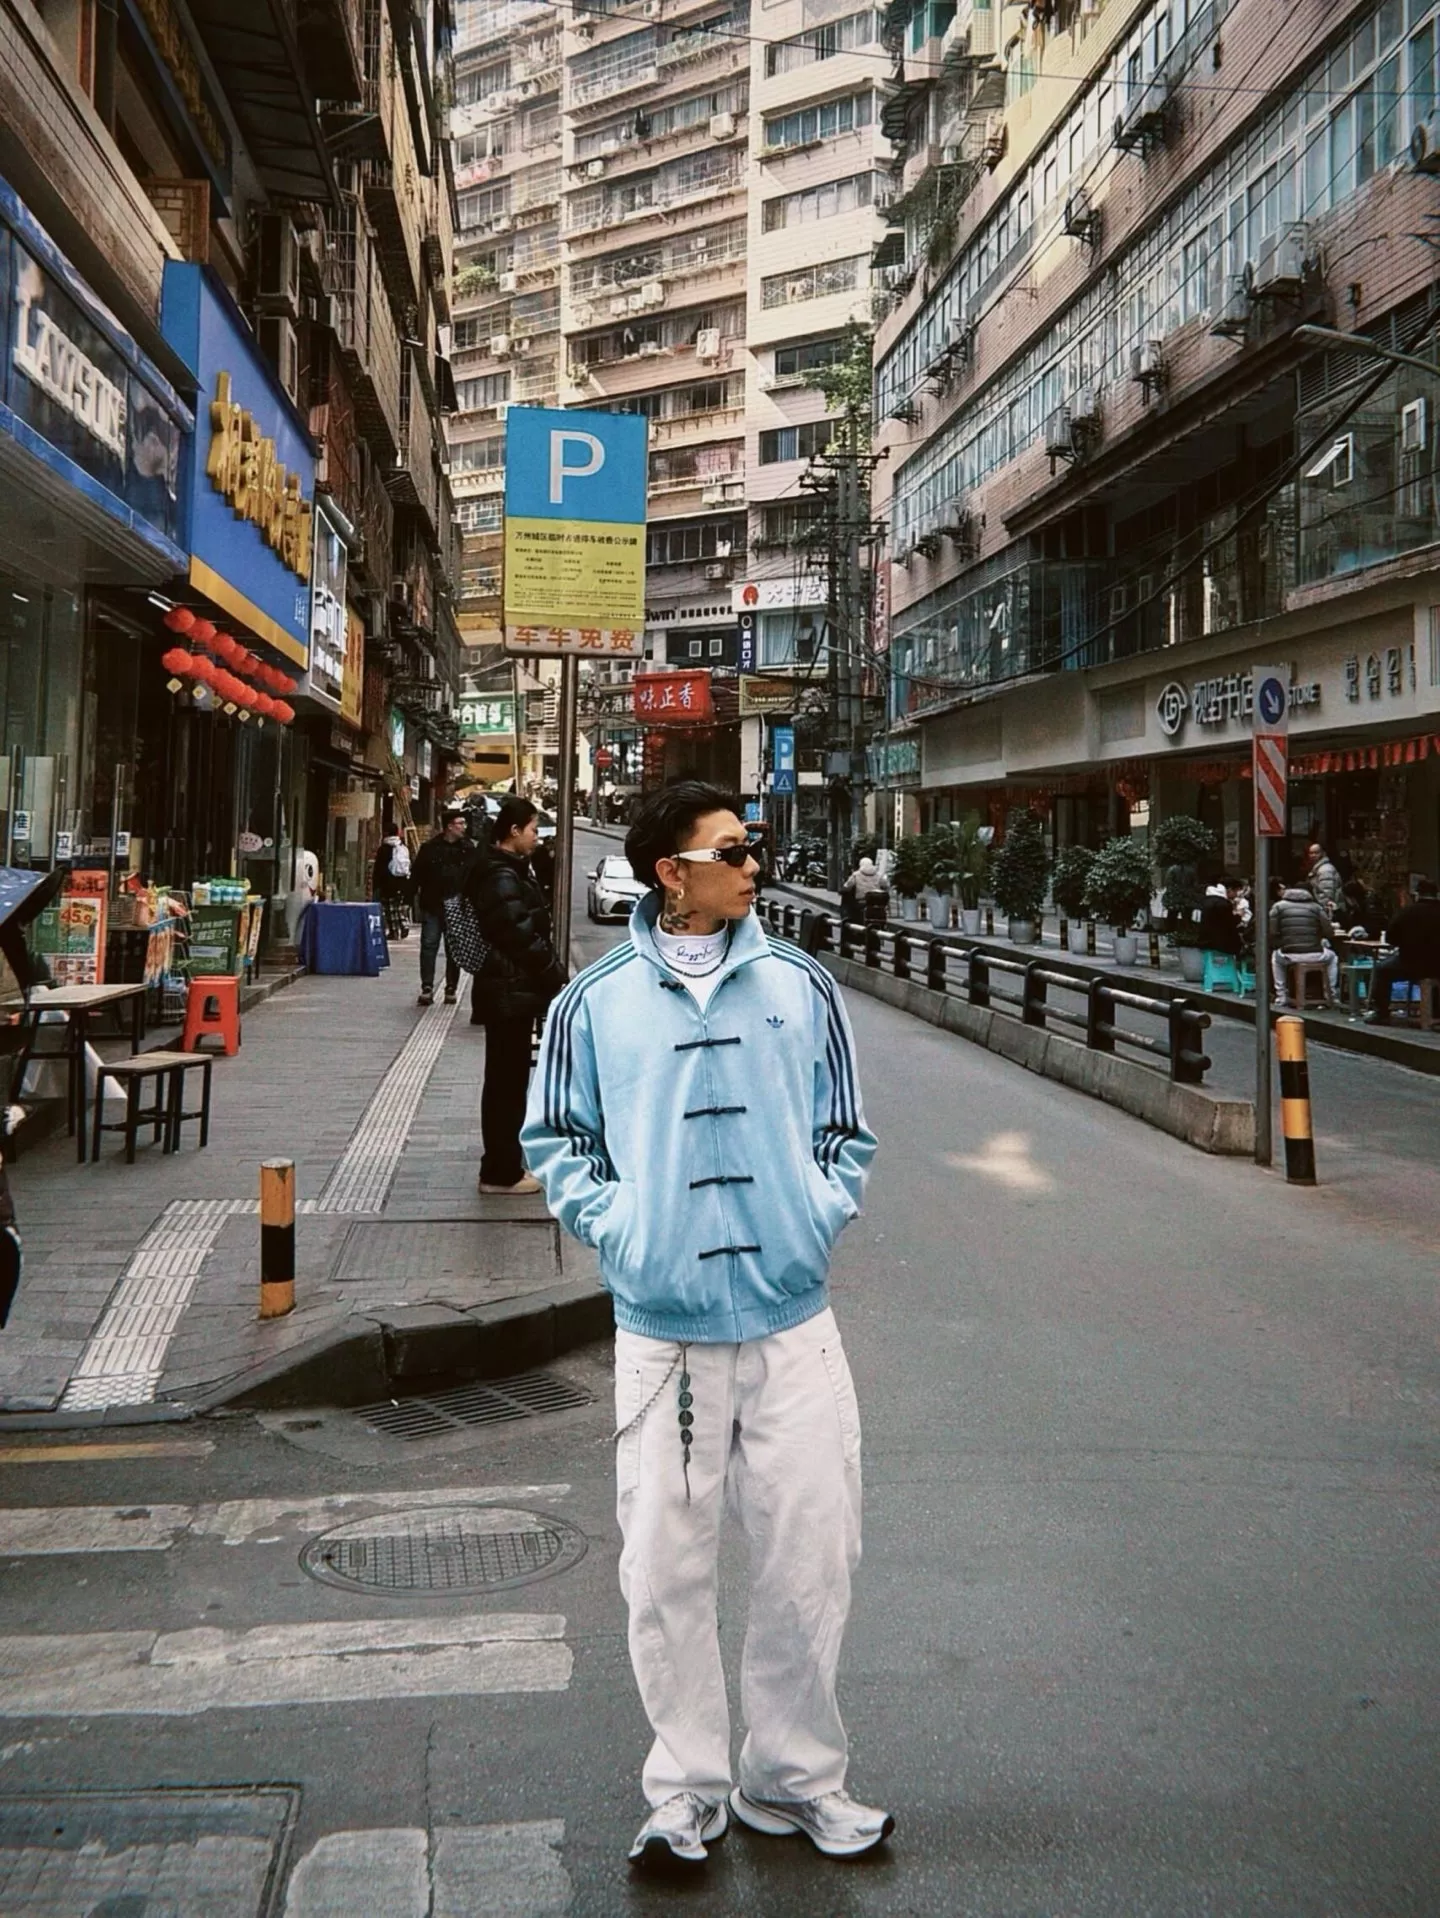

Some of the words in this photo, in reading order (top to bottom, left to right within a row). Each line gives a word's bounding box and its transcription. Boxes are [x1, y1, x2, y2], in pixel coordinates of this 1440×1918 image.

[13, 287, 123, 453] LAWSON
[549, 429, 605, 504] P
[638, 682, 696, 710] 味正香
